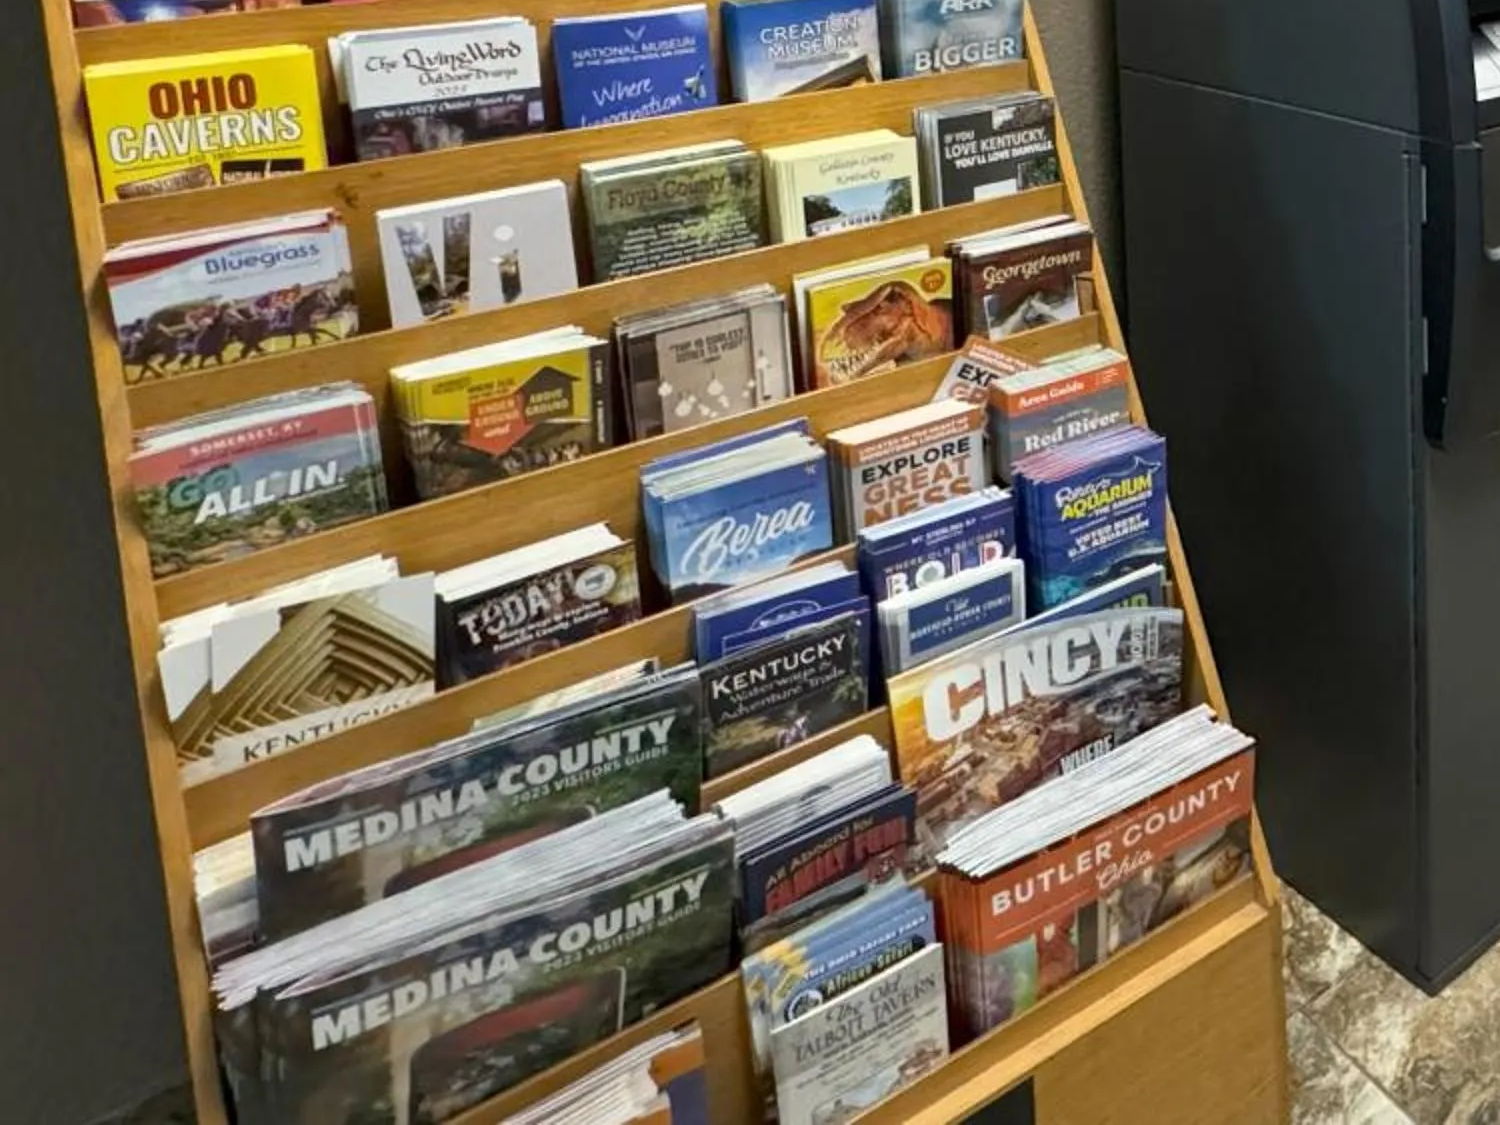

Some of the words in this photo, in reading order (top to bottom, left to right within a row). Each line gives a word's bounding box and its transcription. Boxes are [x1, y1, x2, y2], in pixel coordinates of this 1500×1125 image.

[571, 43, 641, 62] NATIONAL
[641, 35, 697, 53] MUSEUM
[759, 14, 860, 45] CREATION
[768, 33, 855, 60] MUSEUM
[365, 55, 398, 74] The
[465, 39, 522, 62] Word
[913, 36, 1018, 73] BIGGER
[148, 72, 258, 120] OHIO
[591, 76, 655, 108] Where
[107, 106, 303, 164] CAVERNS
[943, 139, 978, 160] LOVE
[955, 130, 975, 141] YOU
[987, 147, 1010, 164] LOVE
[606, 187, 659, 211] Floyd
[663, 173, 727, 198] County
[203, 242, 322, 276] Bluegrass
[982, 249, 1082, 290] Georgetown
[529, 387, 564, 403] ABOVE
[1024, 426, 1064, 453] Red
[1066, 410, 1121, 438] River
[861, 436, 972, 485] EXPLORE
[863, 454, 971, 506] GREAT
[167, 463, 241, 510] GO
[193, 475, 277, 525] ALL
[287, 459, 346, 497] IN.
[1061, 474, 1153, 522] AQUARIUM
[680, 500, 816, 585] Berea
[711, 634, 847, 700] KENTUCKY
[923, 620, 1129, 742] CINCY
[719, 687, 804, 722] Adventure
[553, 760, 624, 793] VISITORS
[623, 744, 670, 772] GUIDE
[283, 779, 491, 873] MEDINA
[496, 714, 677, 798] COUNTY
[991, 839, 1114, 916] BUTLER
[1121, 770, 1242, 848] COUNTY
[1095, 848, 1154, 891] Ohio
[311, 948, 520, 1052] MEDINA
[525, 871, 711, 964] COUNTY
[869, 977, 901, 1005] Old
[793, 1010, 865, 1062] TALBOTT
[870, 974, 936, 1024] TAVERN
